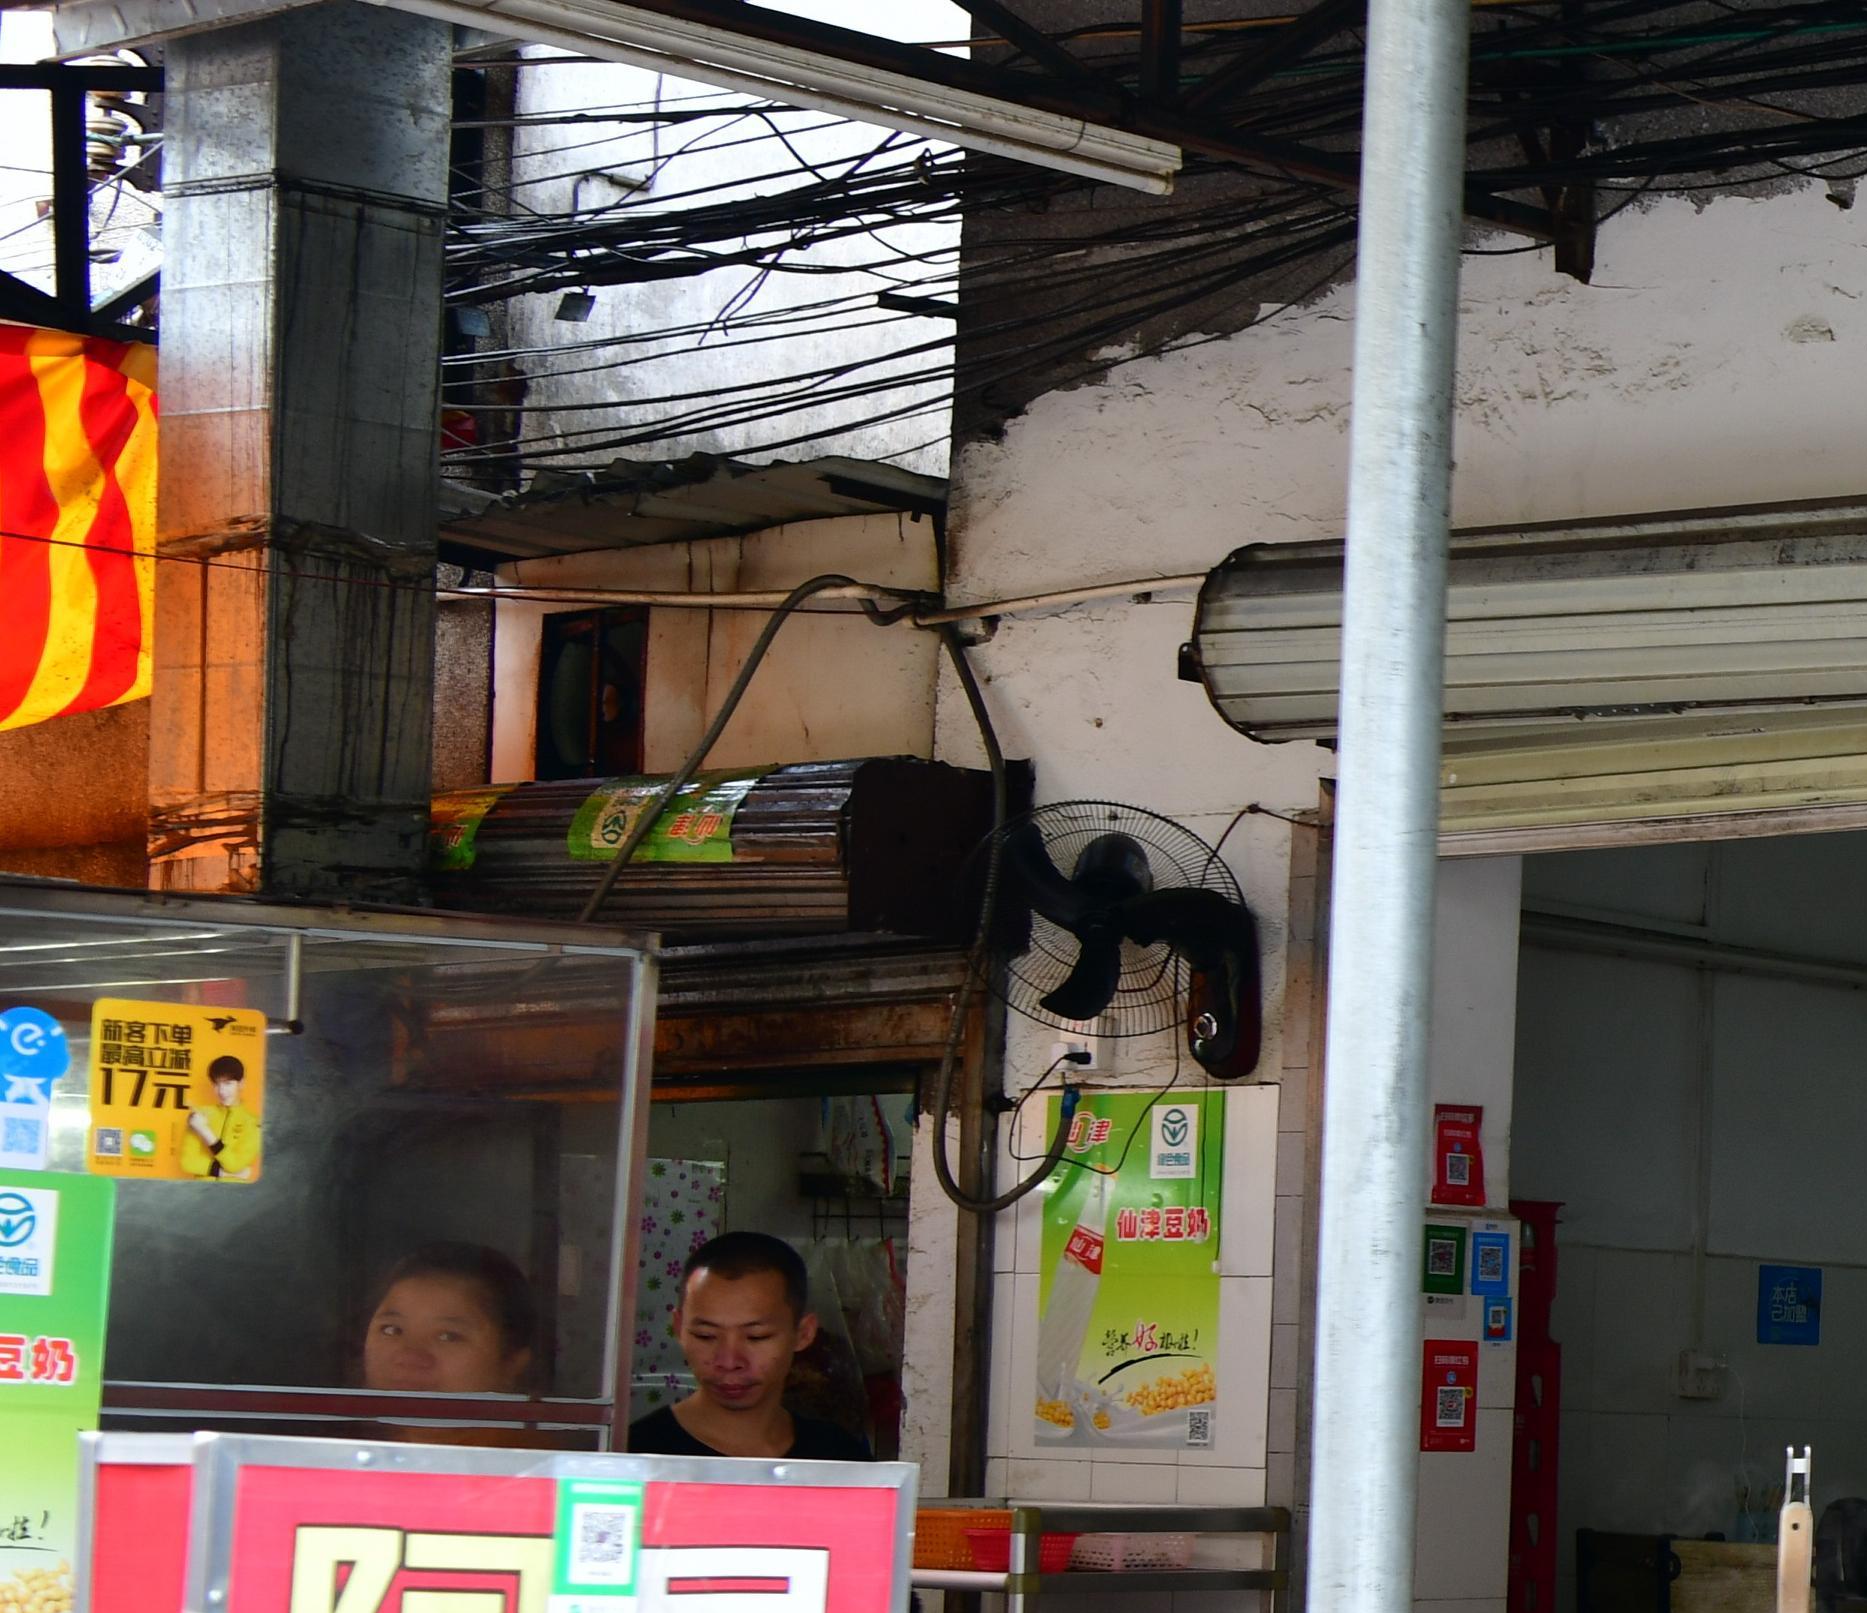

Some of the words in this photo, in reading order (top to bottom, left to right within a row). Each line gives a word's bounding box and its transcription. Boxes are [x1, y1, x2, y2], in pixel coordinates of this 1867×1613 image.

[100, 1017, 194, 1047] 新客下单
[99, 1042, 192, 1070] 最高立减
[98, 1066, 192, 1111] 17元
[1116, 1207, 1209, 1239] 仙津豆奶
